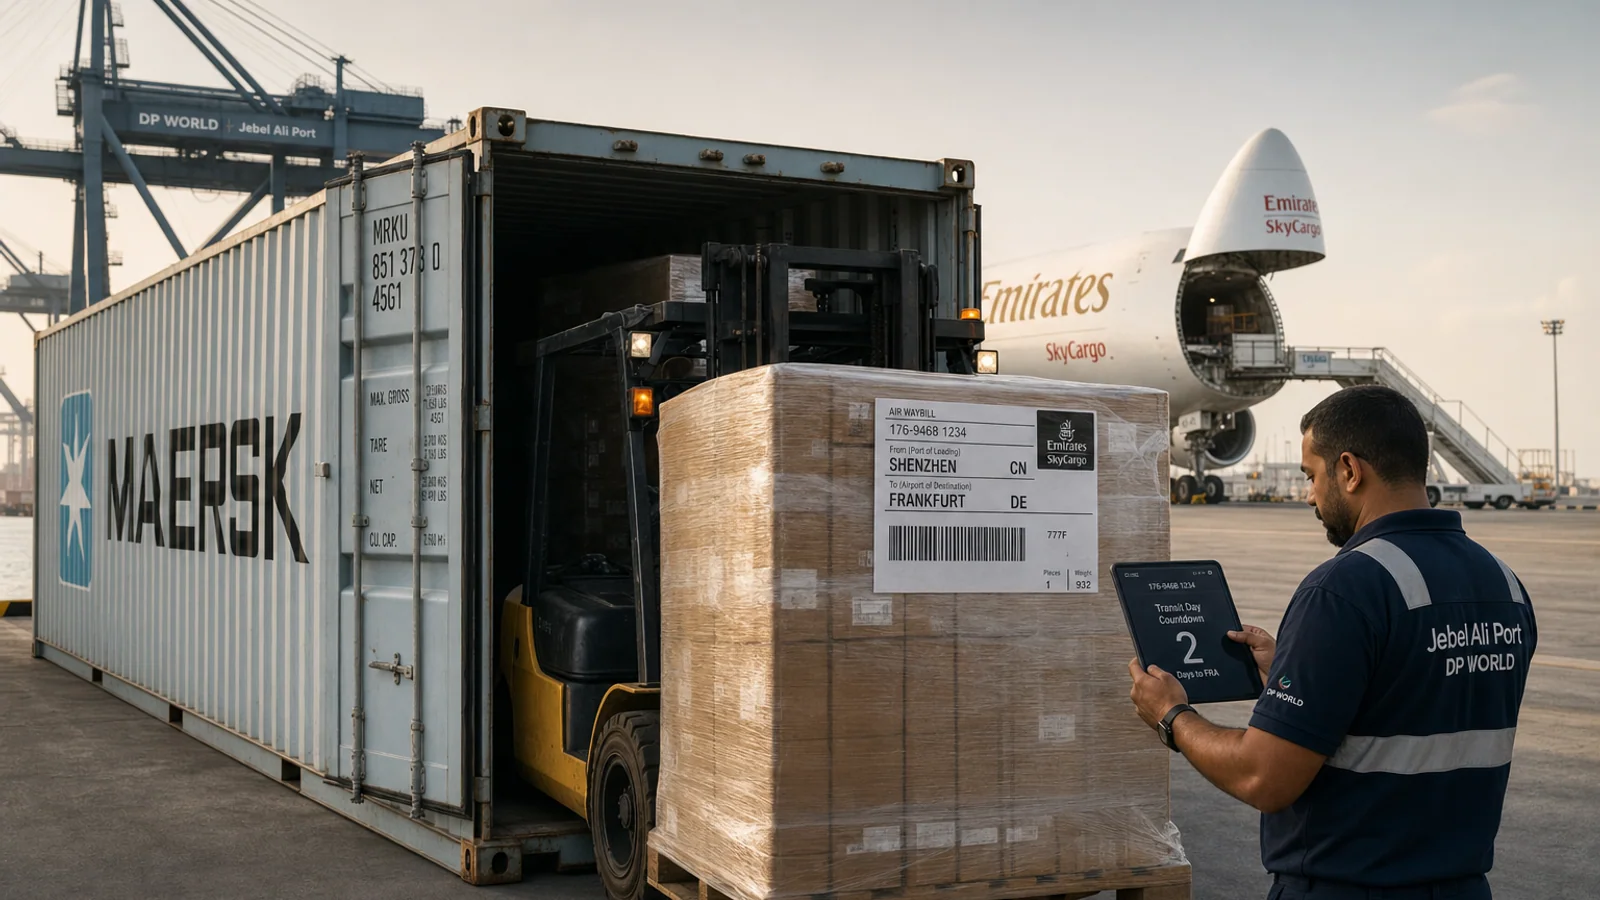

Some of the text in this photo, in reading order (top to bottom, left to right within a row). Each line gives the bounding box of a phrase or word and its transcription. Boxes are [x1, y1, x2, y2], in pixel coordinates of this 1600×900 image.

[139, 112, 316, 139] DP WORLD Jebel Ali Port
[1264, 194, 1319, 215] Emirate
[373, 213, 408, 246] MRKU
[1265, 219, 1321, 238] SkyCargo
[373, 250, 394, 280] 851
[432, 242, 440, 271] 0
[373, 281, 401, 312] 45G1
[981, 270, 1113, 325] Emirates
[1046, 340, 1106, 365] SkyCargo
[370, 391, 387, 406] MAX.
[388, 388, 410, 404] GROSS
[889, 407, 936, 418] AIR WAYBILL
[890, 423, 967, 438] 176-9468 1234
[370, 437, 388, 453] TARE
[889, 445, 906, 454] From
[925, 447, 933, 455] of
[1047, 440, 1087, 452] Emirates
[889, 457, 1027, 475] SHENZHEN CN
[1047, 454, 1087, 467] SkyCargo
[107, 412, 310, 564] MAERSK
[369, 479, 383, 494] NET
[889, 480, 898, 489] To
[889, 492, 1027, 509] FRANKFURT DE
[369, 532, 397, 548] CU. CAP.
[1047, 530, 1067, 539] 777F
[1043, 569, 1061, 577] Pieces
[1046, 580, 1050, 589] 1
[1076, 580, 1091, 589] 932
[1154, 602, 1201, 613] Transit Day
[1158, 614, 1205, 625] Countdown
[1427, 622, 1522, 653] Jebel Ali Port
[1176, 631, 1204, 664] 2
[1446, 653, 1515, 677] DP WORLD
[1176, 668, 1220, 680] Days to FRA
[1276, 691, 1304, 707] WORLD
